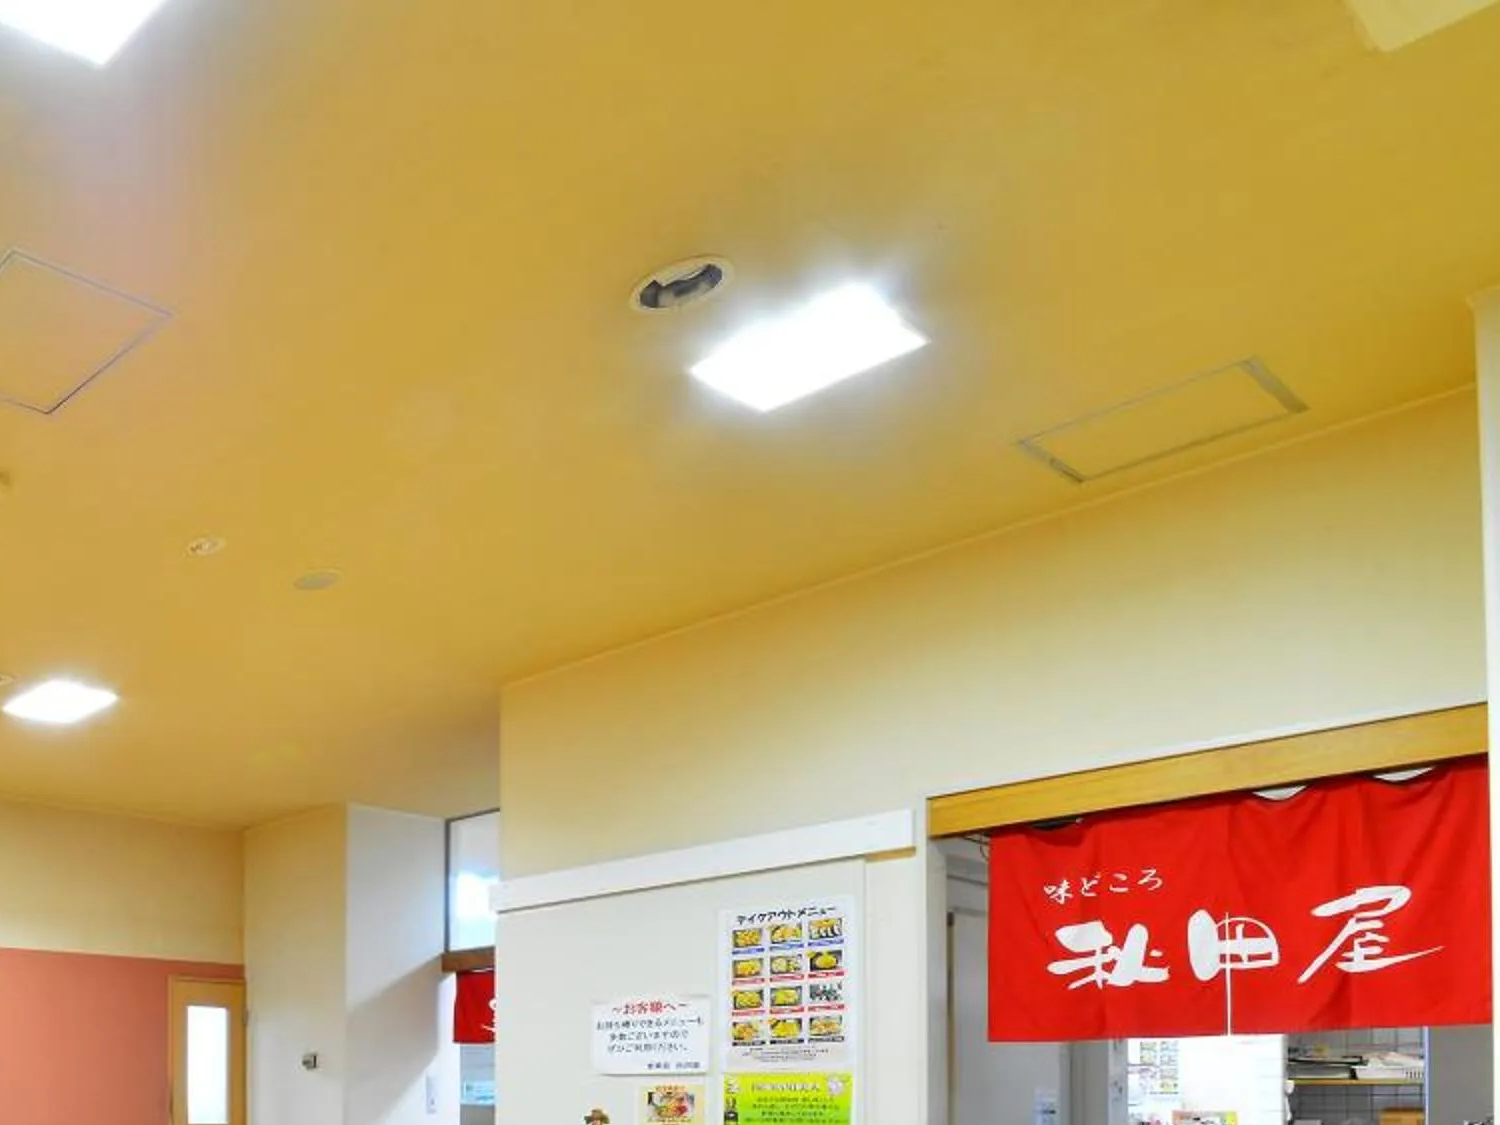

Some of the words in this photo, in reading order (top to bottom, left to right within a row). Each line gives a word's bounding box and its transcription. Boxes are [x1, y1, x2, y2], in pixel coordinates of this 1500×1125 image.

[1043, 867, 1164, 906] 味どころ
[736, 905, 836, 926] テイクアウトメニュー
[1047, 885, 1445, 990] 秋田屋
